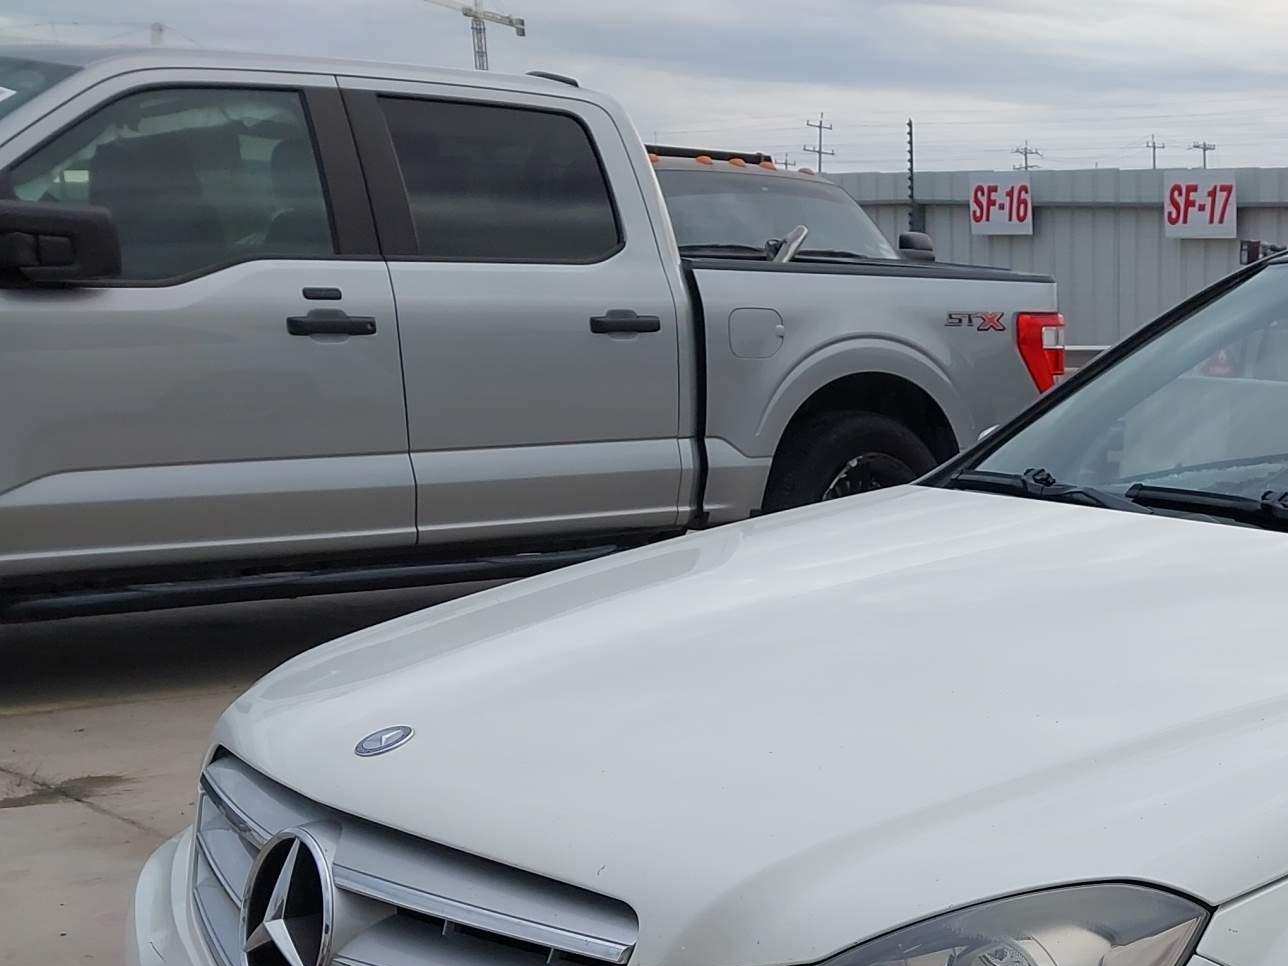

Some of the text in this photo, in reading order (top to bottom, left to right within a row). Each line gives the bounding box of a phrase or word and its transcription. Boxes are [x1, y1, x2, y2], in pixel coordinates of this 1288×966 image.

[972, 184, 1030, 223] SF-16
[1167, 184, 1233, 225] SF-17
[944, 312, 1006, 332] STX
